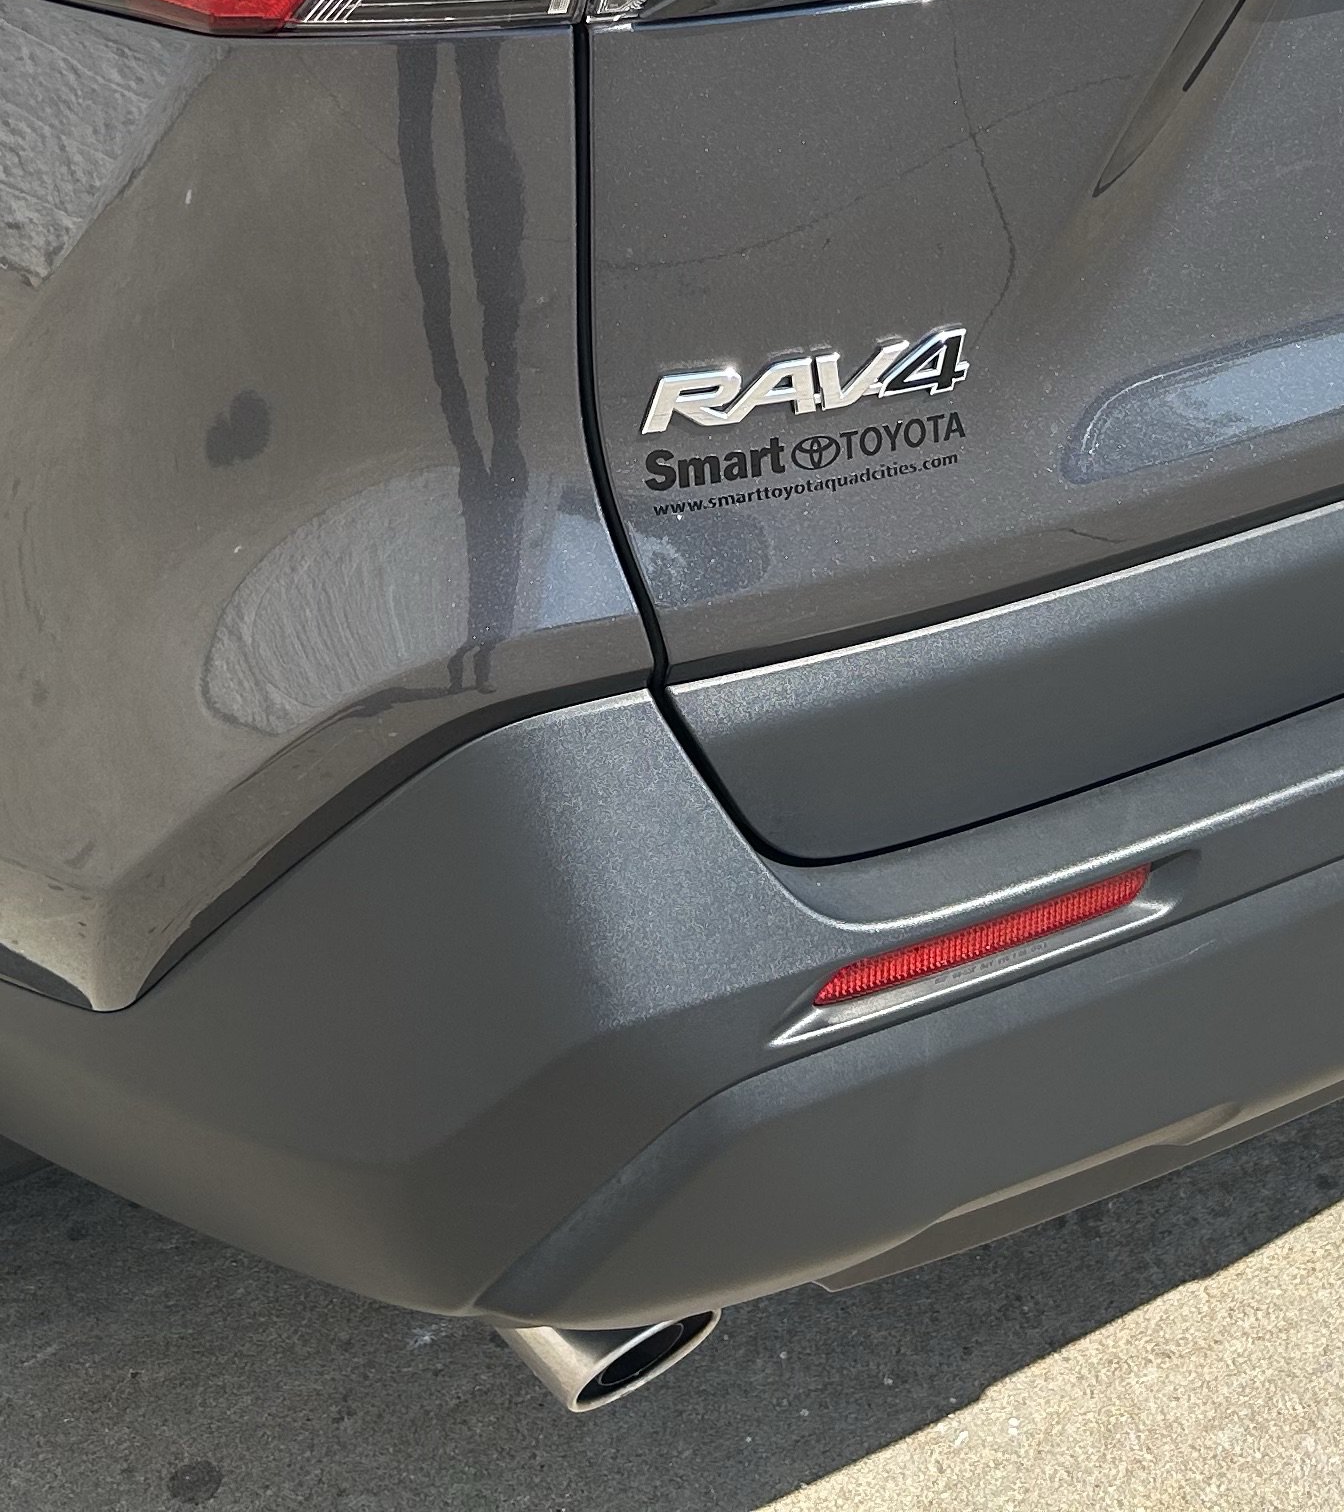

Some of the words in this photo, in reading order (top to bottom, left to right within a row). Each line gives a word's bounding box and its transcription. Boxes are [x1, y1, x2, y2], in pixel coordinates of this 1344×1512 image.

[641, 324, 971, 435] RAV4
[644, 436, 786, 491] Smart
[839, 411, 967, 461] TOYOTA
[653, 453, 959, 516] www.smarttoyotaquadcities.com
